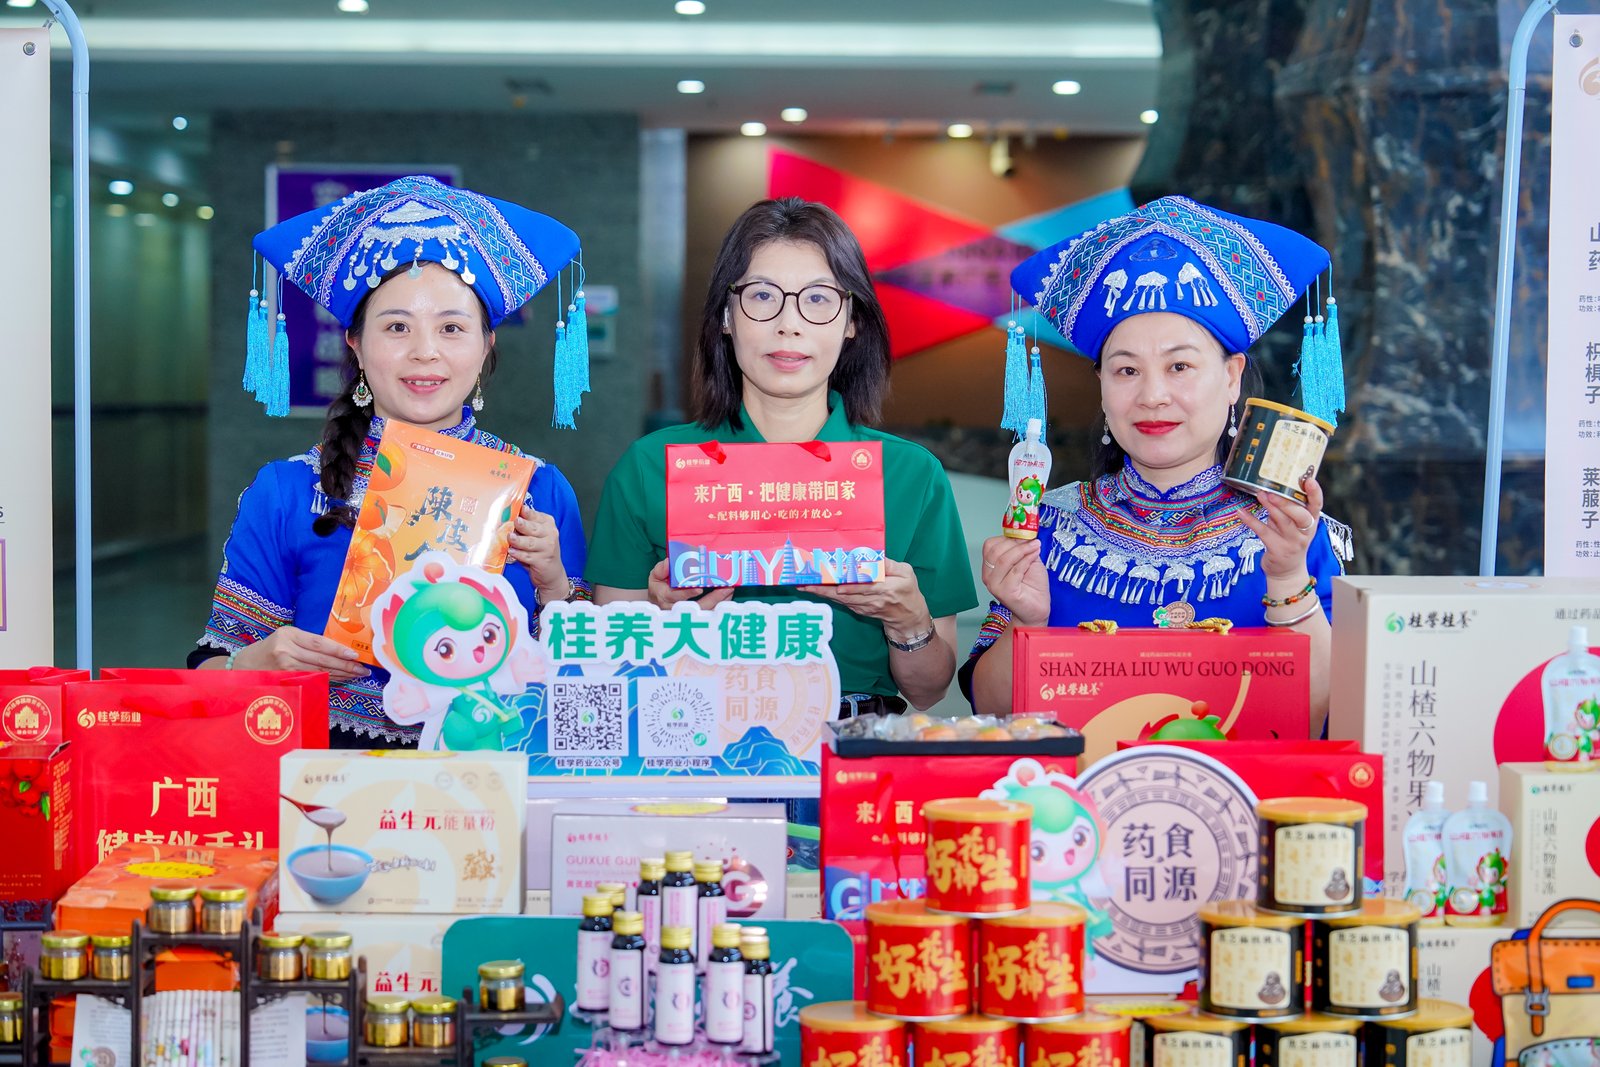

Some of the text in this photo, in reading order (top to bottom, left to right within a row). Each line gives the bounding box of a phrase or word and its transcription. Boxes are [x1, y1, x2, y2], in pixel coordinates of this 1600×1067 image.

[1582, 467, 1600, 529] 莱菔子
[548, 612, 824, 661] 桂养大健康
[1040, 660, 1295, 677] SHAN ZHA LIU WU GUO DONG
[1406, 660, 1436, 816] 山楂六物果
[557, 759, 620, 767] 桂学药业公众号
[647, 759, 710, 767] 桂学药业小程序
[151, 776, 220, 818] 广西
[1122, 822, 1194, 860] 药食
[566, 855, 610, 865] GUIXUE
[1124, 865, 1198, 902] 同源
[374, 973, 438, 992] 益生元
